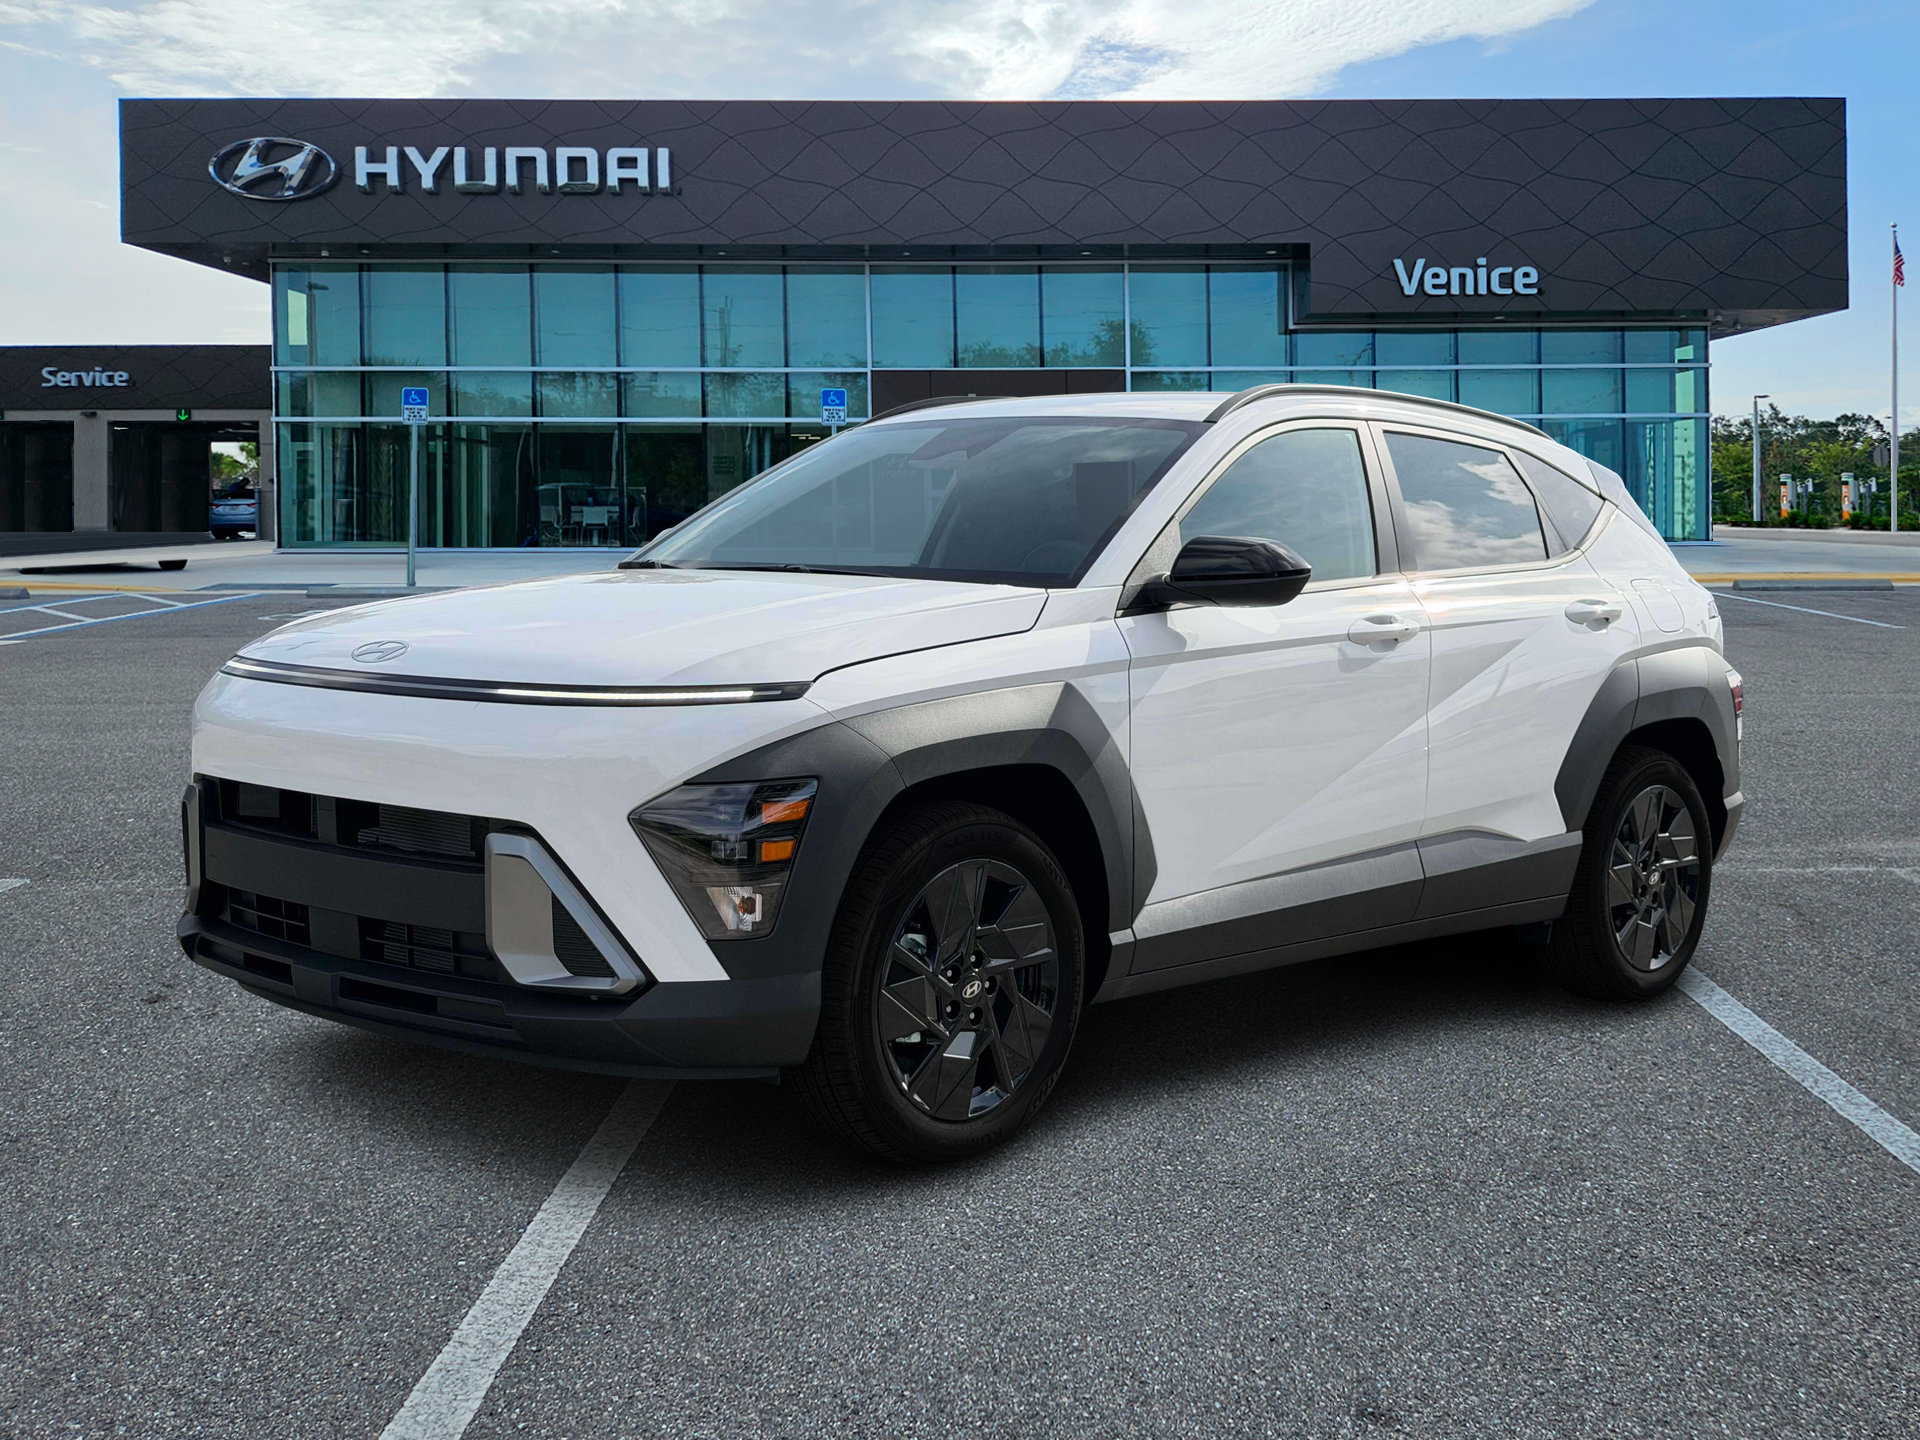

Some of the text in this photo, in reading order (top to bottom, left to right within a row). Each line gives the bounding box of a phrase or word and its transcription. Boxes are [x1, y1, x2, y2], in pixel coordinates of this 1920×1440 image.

[354, 145, 672, 195] HYUNDAI
[1392, 256, 1539, 296] Venice
[41, 366, 130, 387] Service
[877, 469, 919, 478] HYUNDAI
[942, 831, 1005, 853] SOLUS
[862, 931, 882, 1010] ALL-SEASON
